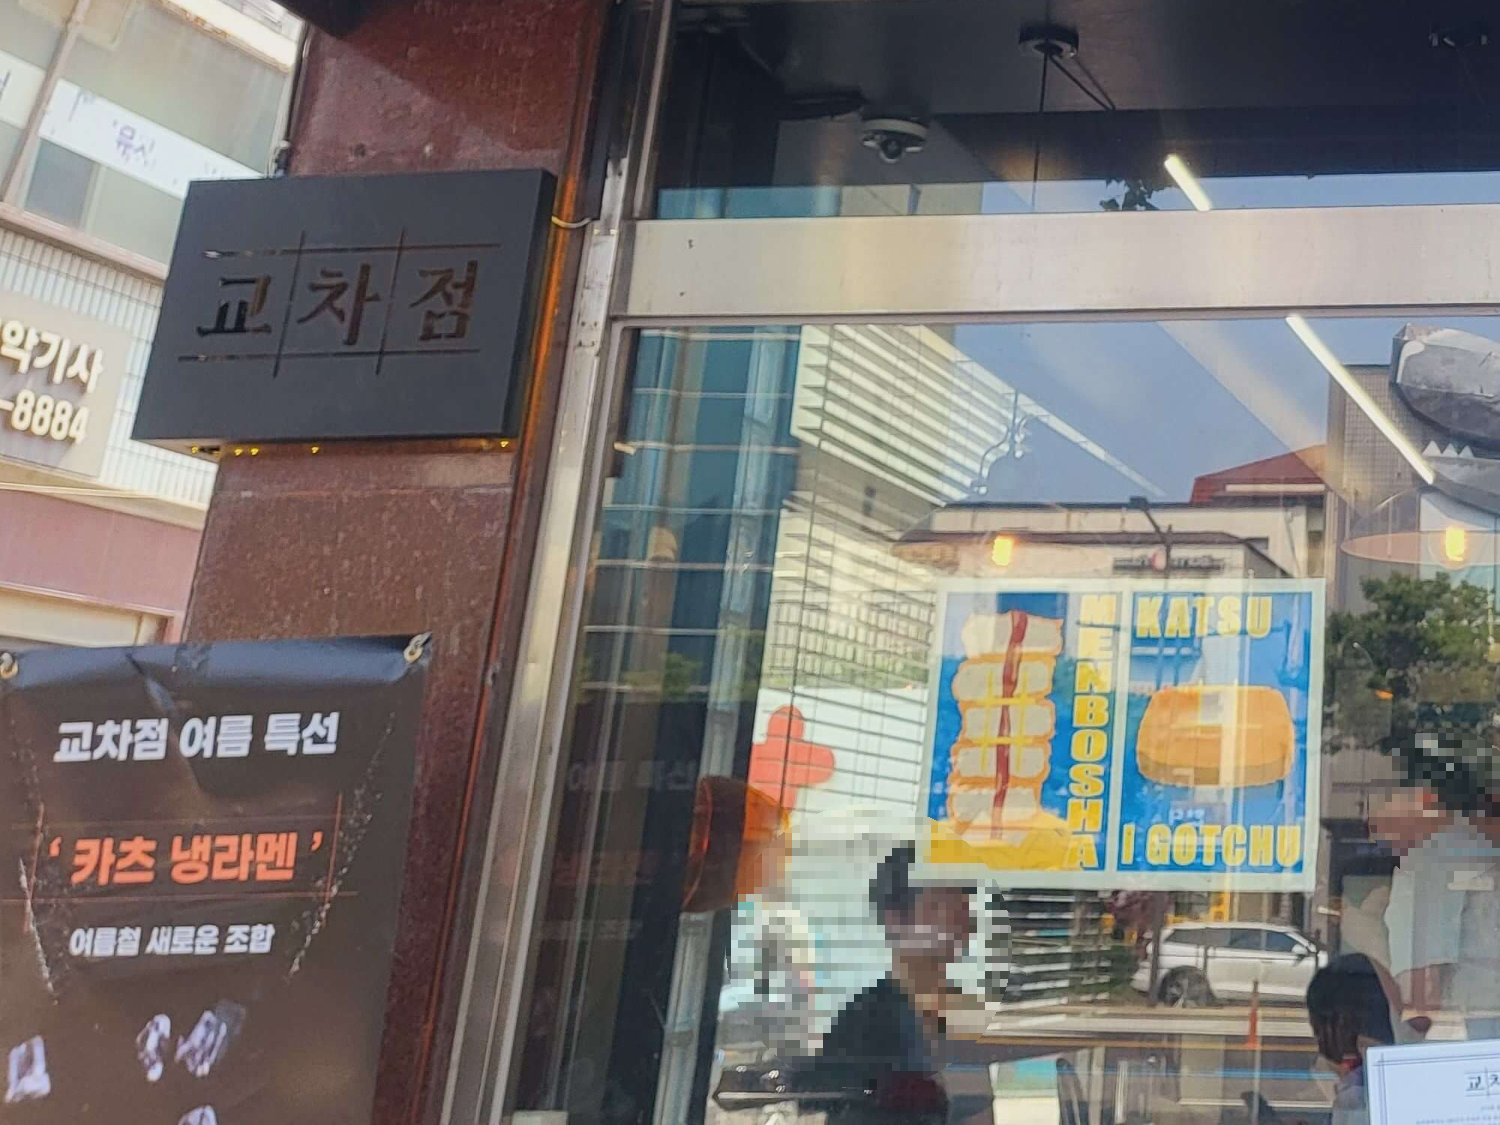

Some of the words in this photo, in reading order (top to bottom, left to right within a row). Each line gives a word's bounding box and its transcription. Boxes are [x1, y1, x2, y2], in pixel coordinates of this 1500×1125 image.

[196, 260, 479, 347] 교차점
[1136, 594, 1273, 639] KATSU
[53, 718, 169, 763] 교차점
[179, 715, 254, 759] 여름
[264, 712, 340, 757] 특선
[1067, 594, 1118, 869] MENBOSHA
[70, 836, 158, 886] 카츠
[171, 831, 298, 884] 냉라멘
[1120, 822, 1136, 866] I
[1146, 823, 1301, 868] GOTCHU
[69, 927, 142, 957] 여름철
[145, 924, 220, 955] 새로운
[223, 923, 276, 955] 조합
